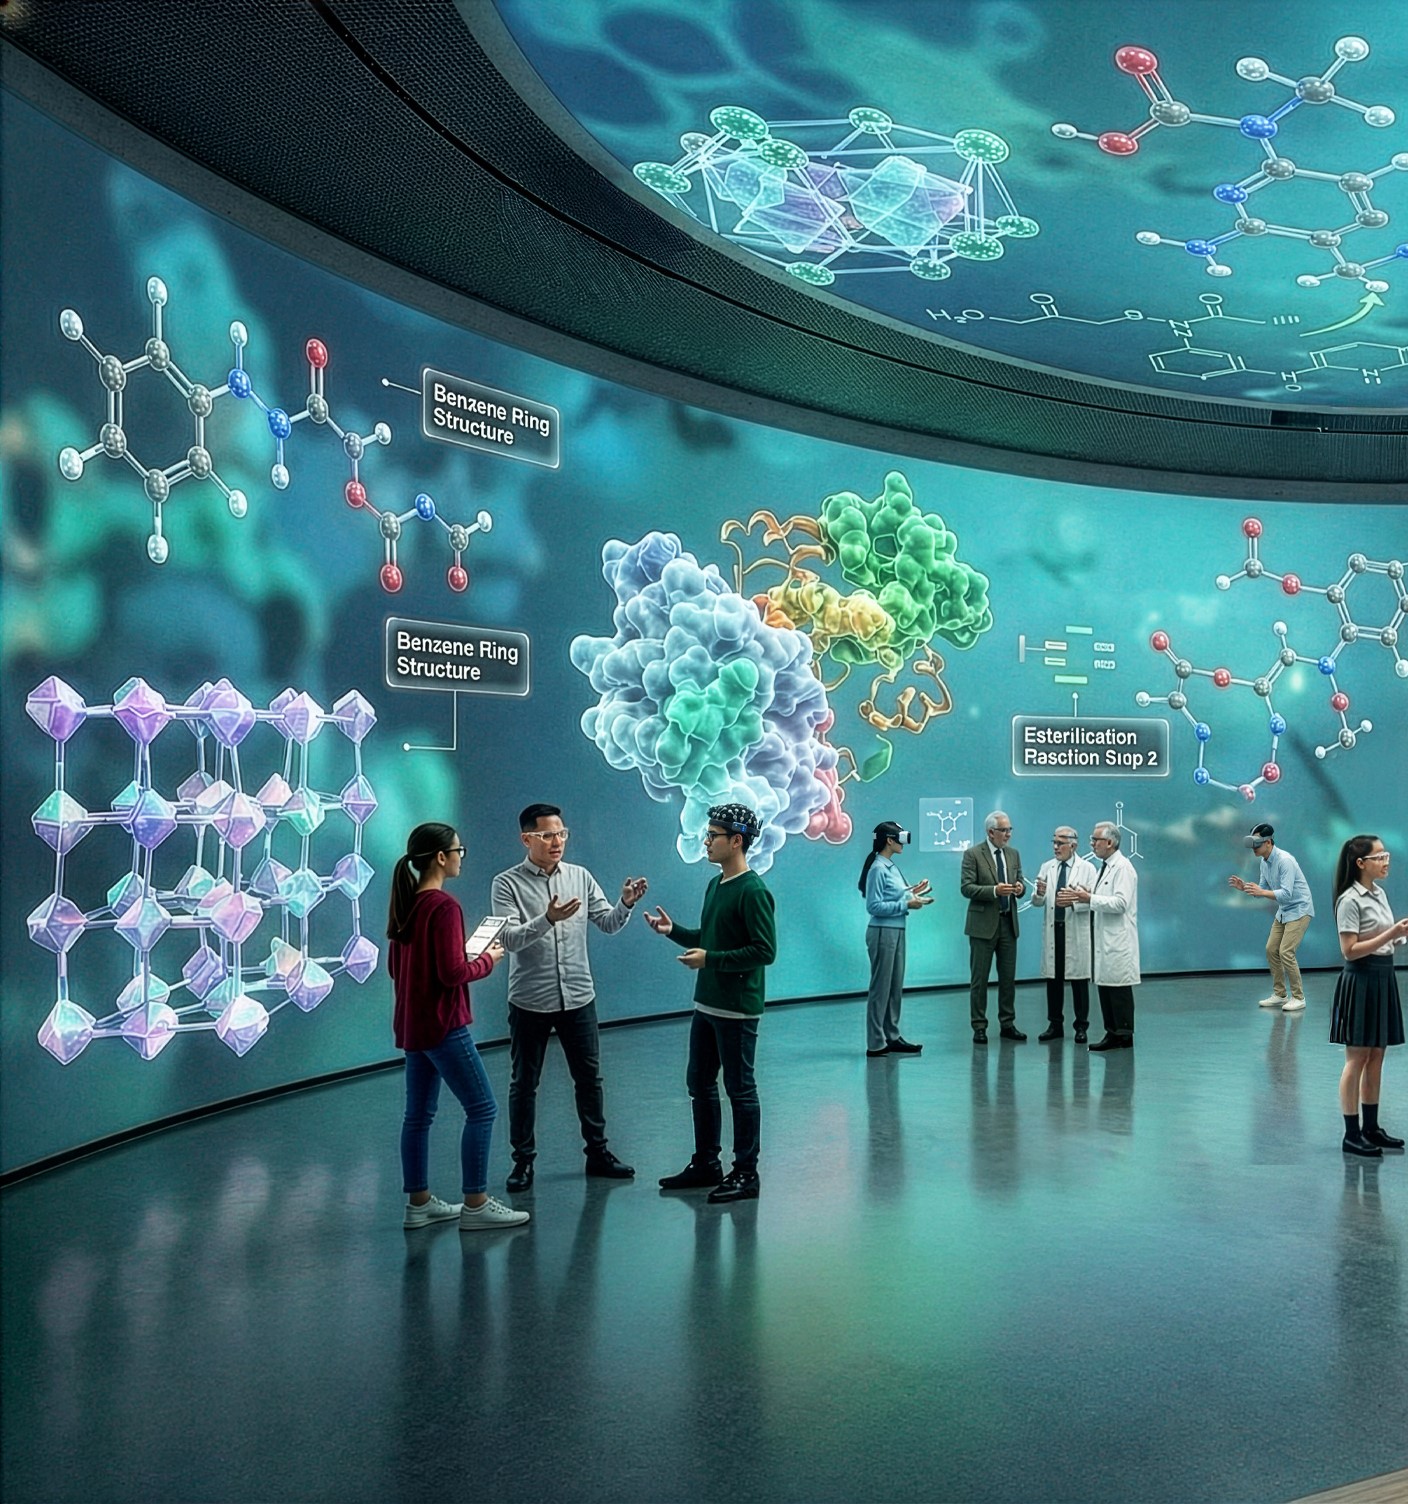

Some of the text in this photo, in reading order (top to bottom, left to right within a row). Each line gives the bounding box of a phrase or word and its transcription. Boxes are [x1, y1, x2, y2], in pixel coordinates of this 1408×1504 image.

[433, 407, 514, 445] Structure
[434, 383, 550, 437] Benzene Ring
[397, 631, 518, 666] Benzene Ring
[397, 656, 481, 681] Structure
[1147, 751, 1158, 766] 2
